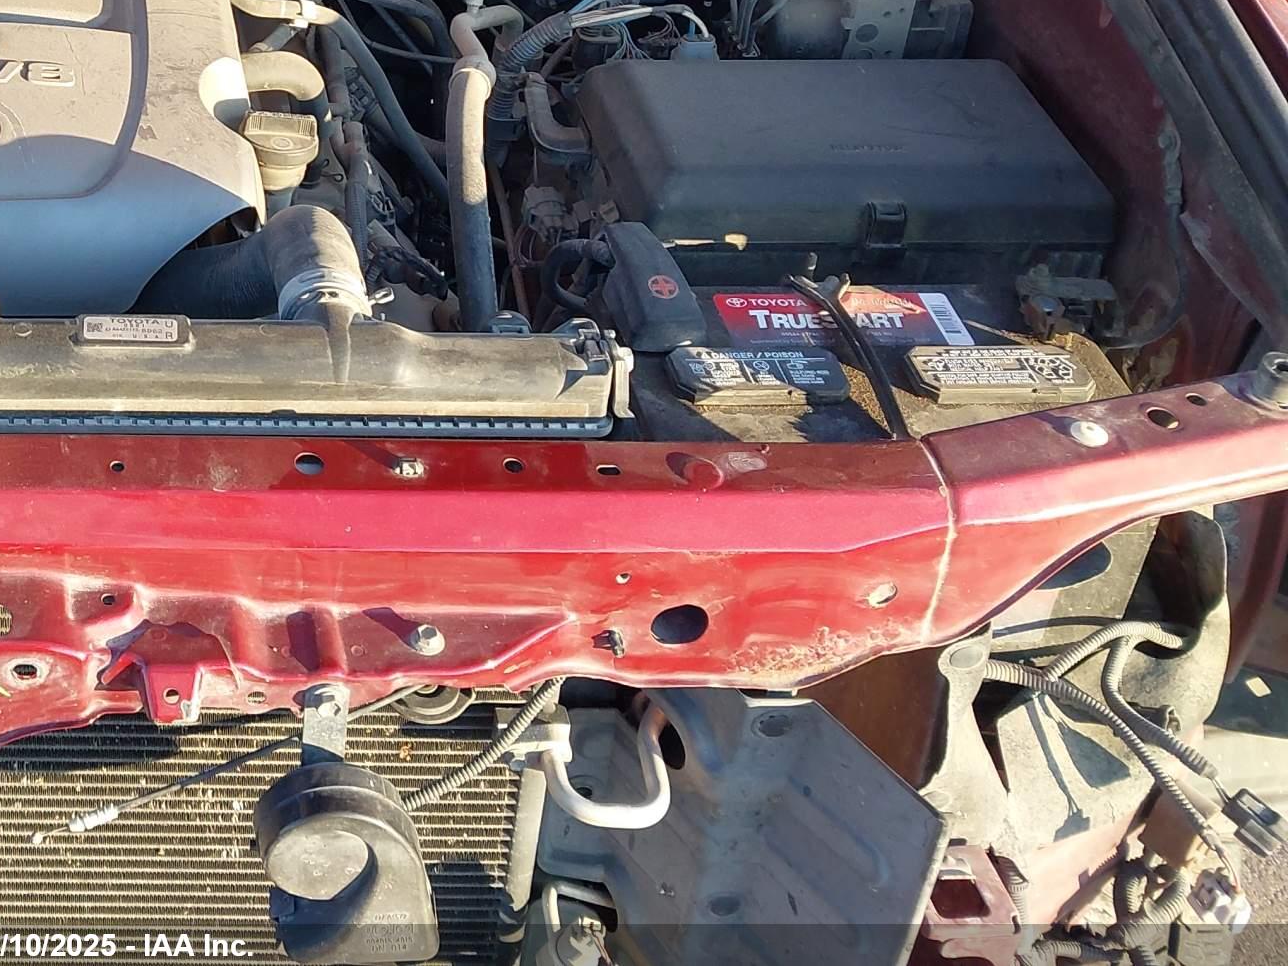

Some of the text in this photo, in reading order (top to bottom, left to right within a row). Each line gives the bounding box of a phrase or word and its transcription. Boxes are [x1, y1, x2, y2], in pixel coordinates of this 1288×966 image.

[748, 298, 808, 308] TOYOTA
[164, 320, 174, 329] U
[749, 310, 905, 331] TRUESART
[710, 351, 754, 359] DANGER
[764, 351, 804, 359] POISON
